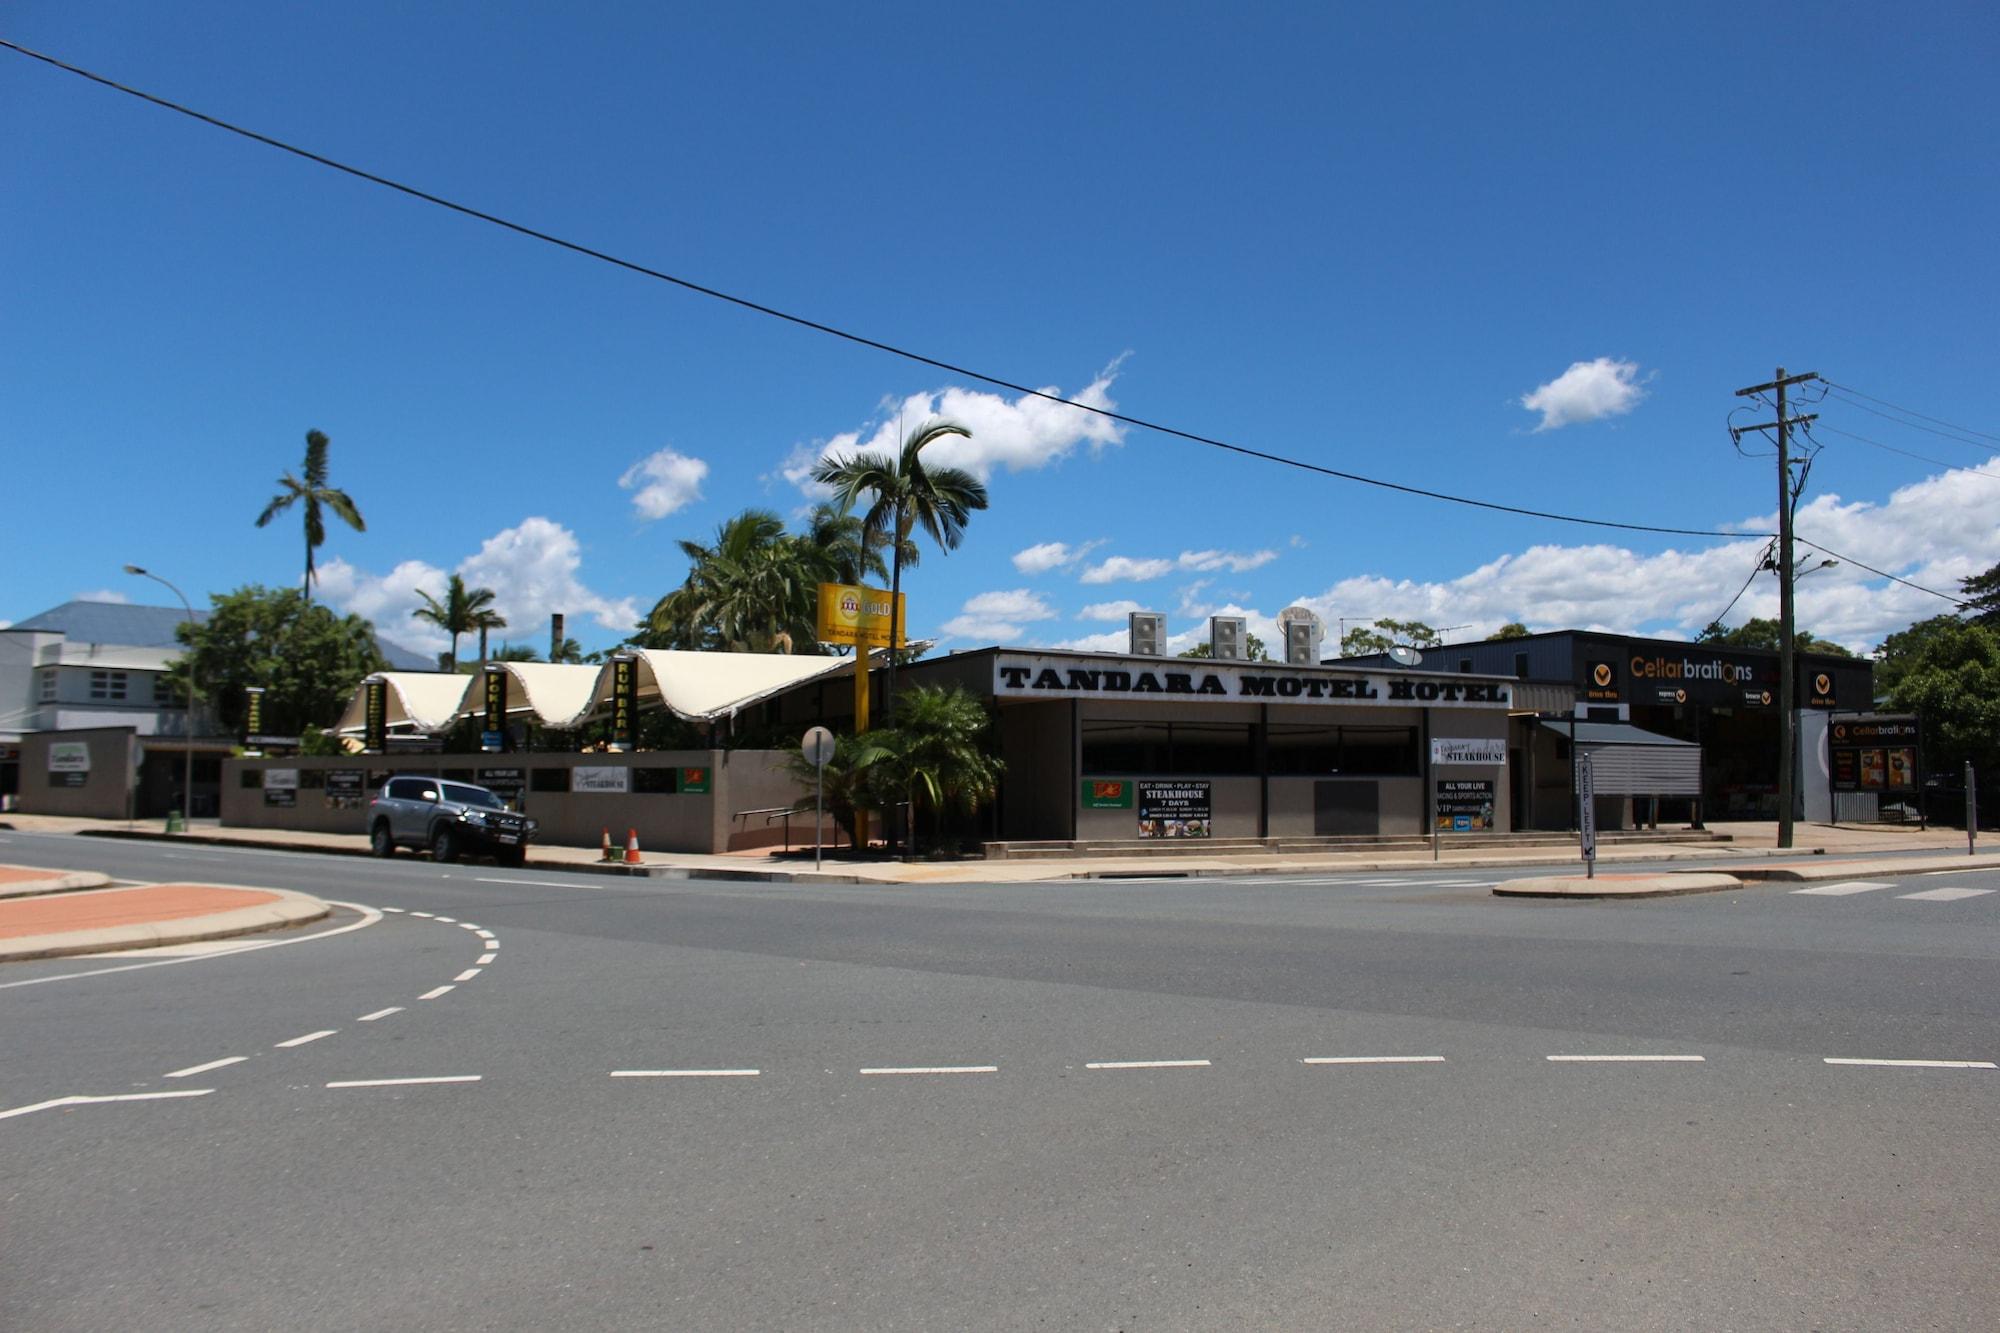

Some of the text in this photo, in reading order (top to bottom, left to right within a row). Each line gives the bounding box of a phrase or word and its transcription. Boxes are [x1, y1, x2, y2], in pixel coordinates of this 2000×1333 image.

[863, 601, 891, 616] GOLD
[1631, 656, 1753, 684] Cellarbrations
[1000, 667, 1508, 702] TANDARA MOTEL HOTEL
[489, 674, 499, 730] POKIES
[616, 663, 629, 728] RUM BAR
[1448, 752, 1504, 761] STEAKHOUSE
[1146, 790, 1205, 799] STEAKHOUSE
[1445, 782, 1485, 790] ALL YOUR LIVE
